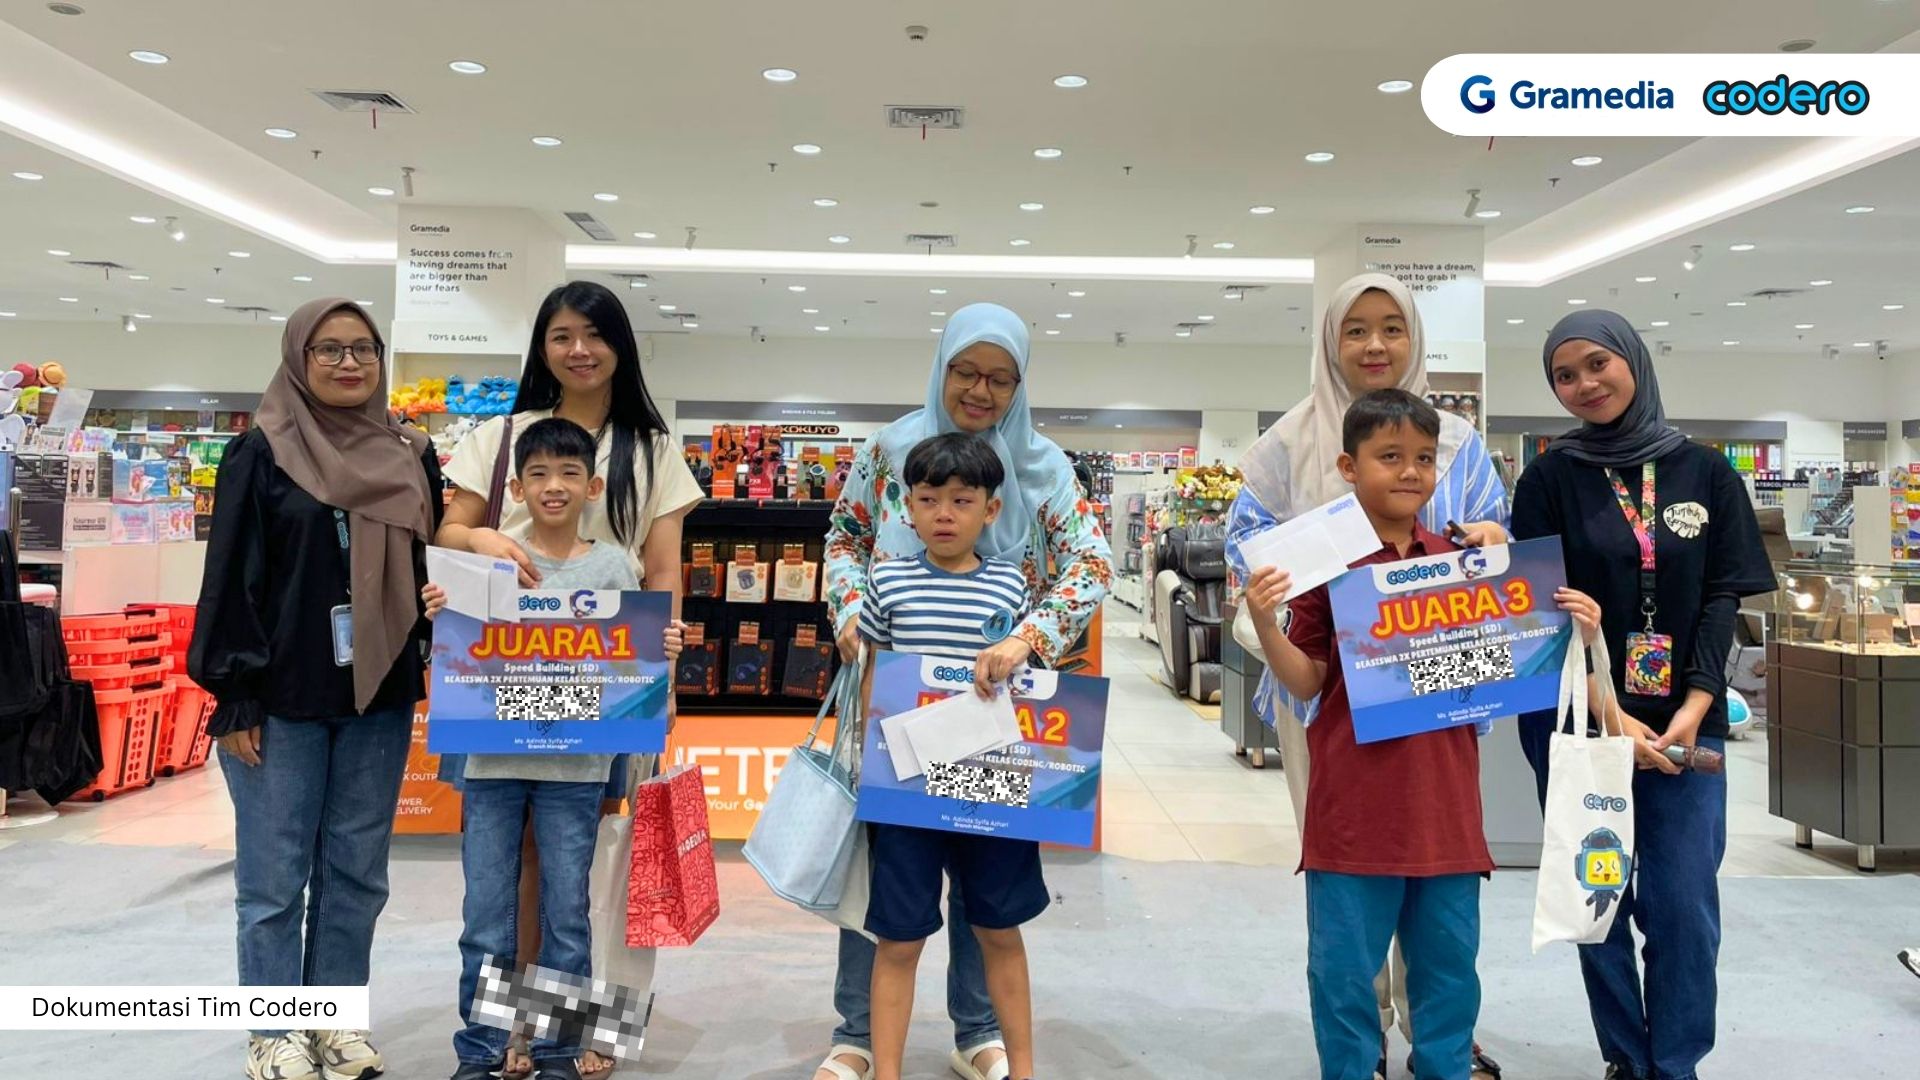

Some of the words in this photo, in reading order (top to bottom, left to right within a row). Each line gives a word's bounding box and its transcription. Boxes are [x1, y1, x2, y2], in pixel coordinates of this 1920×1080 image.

[410, 224, 450, 233] Gramedia
[410, 248, 450, 258] Success
[453, 250, 486, 258] comes
[409, 261, 444, 271] having
[447, 261, 484, 270] dreams
[487, 262, 507, 270] that
[1394, 264, 1410, 272] you
[1413, 263, 1434, 271] have
[1444, 263, 1476, 272] dream,
[429, 272, 462, 281] bigger
[465, 272, 488, 281] than
[1397, 274, 1413, 282] got
[1426, 274, 1448, 282] grab
[409, 284, 432, 293] your
[435, 284, 460, 292] fears
[428, 333, 449, 341] TOYS
[459, 334, 488, 342] GAMES
[780, 425, 838, 434] KOKUYO
[1386, 562, 1451, 585] codero
[519, 594, 561, 611] dero
[1373, 586, 1502, 639] JUARA
[1507, 581, 1531, 612] 3
[1409, 636, 1438, 648] Speed
[1441, 627, 1479, 642] Building
[1480, 624, 1501, 635] (SD)
[471, 625, 604, 659] JUARA
[610, 626, 633, 658] 1
[1355, 654, 1398, 670] BEASISWA
[1399, 653, 1410, 661] 2X
[1411, 644, 1459, 660] PERTEMUAN
[1460, 639, 1486, 651] KELAS
[504, 663, 534, 675] Speed
[535, 663, 576, 674] Building
[577, 663, 599, 673] (SD)
[444, 675, 488, 684] BEASISWA
[490, 675, 501, 684] 2X
[503, 676, 553, 684] PERTEMUAN
[554, 676, 579, 684] KELAS
[933, 666, 974, 684] code
[1044, 711, 1068, 743] 2
[1010, 744, 1031, 755] (SD)
[986, 754, 1011, 765] KELAS
[411, 773, 438, 781] OUTP
[708, 800, 738, 811] Your
[743, 800, 765, 811] Ga
[396, 807, 433, 815] ELIVERY
